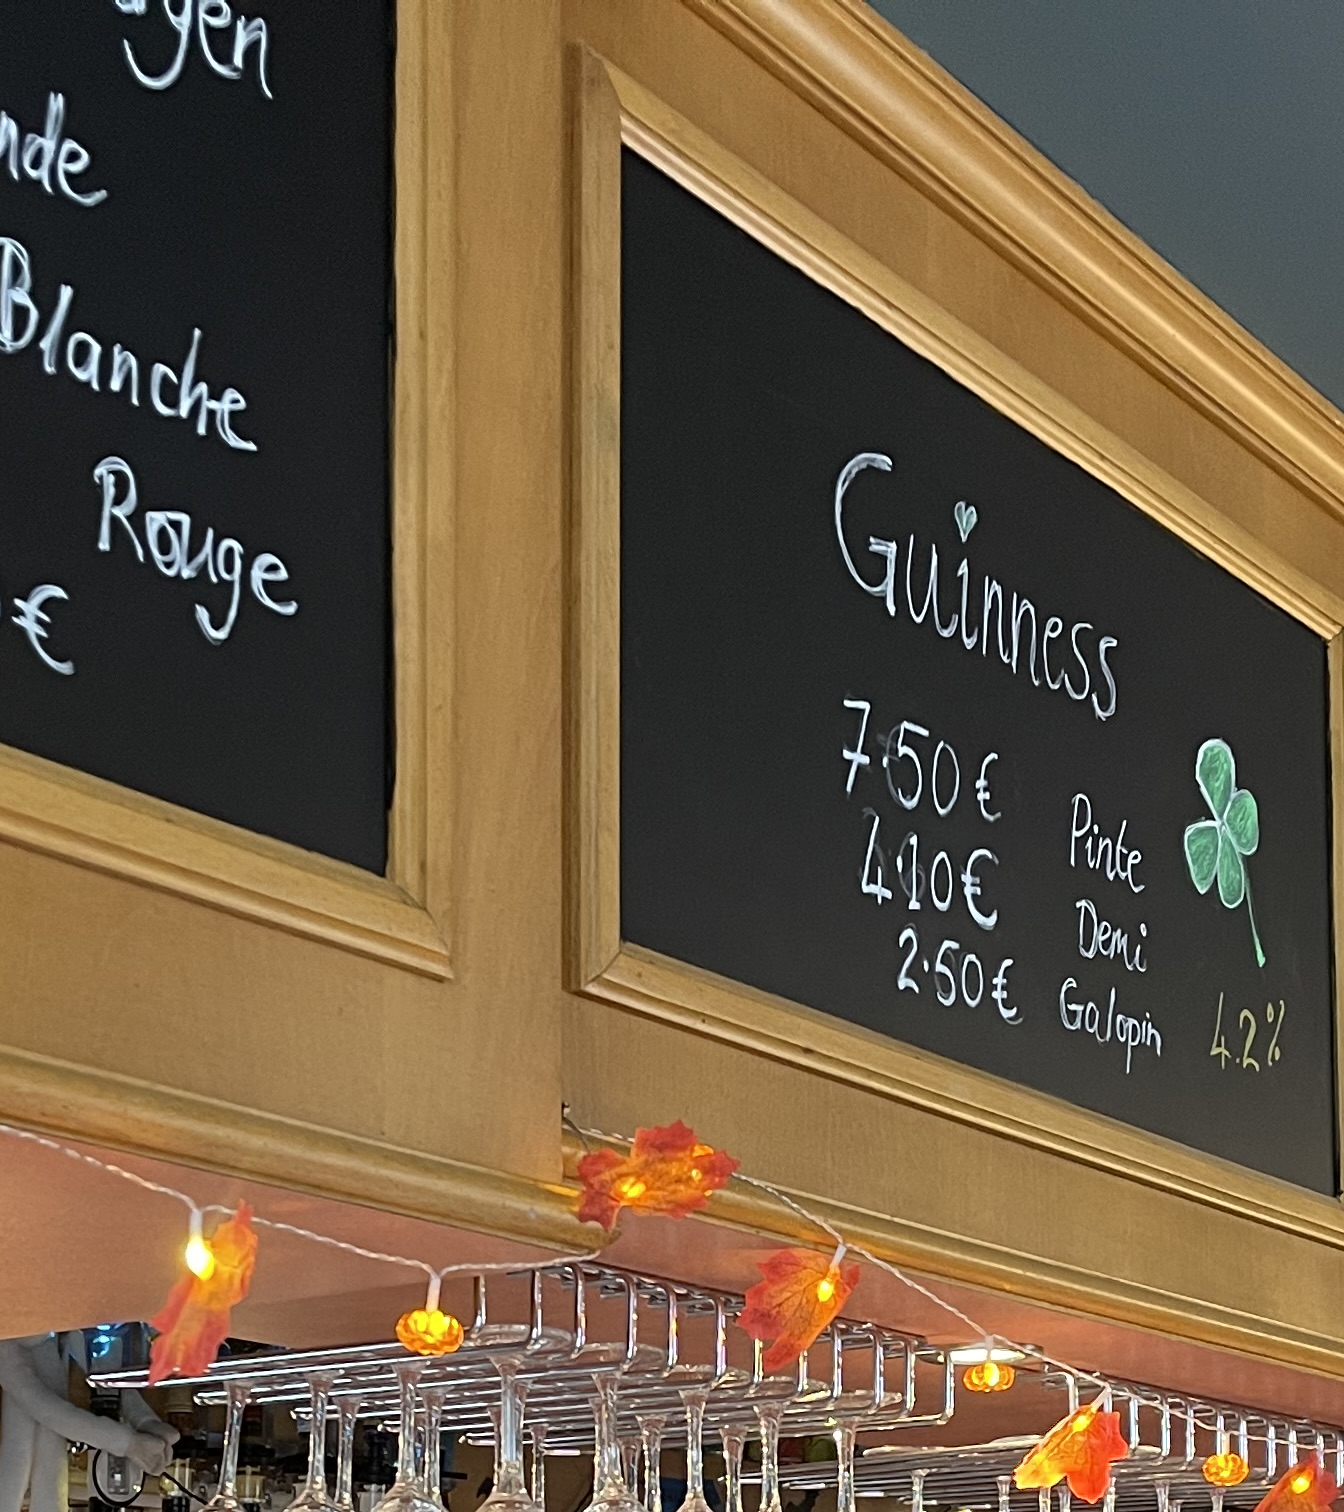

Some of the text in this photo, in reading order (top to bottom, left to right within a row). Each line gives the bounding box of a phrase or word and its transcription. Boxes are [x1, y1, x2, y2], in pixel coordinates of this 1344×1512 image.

[114, 0, 273, 99] gen
[93, 455, 300, 645] Rouge
[835, 452, 1119, 720] Guinness
[1070, 793, 1145, 894] Pinte
[1076, 899, 1147, 972] Demi
[1059, 977, 1161, 1073] Galopin
[1210, 991, 1286, 1072] 4.2%
